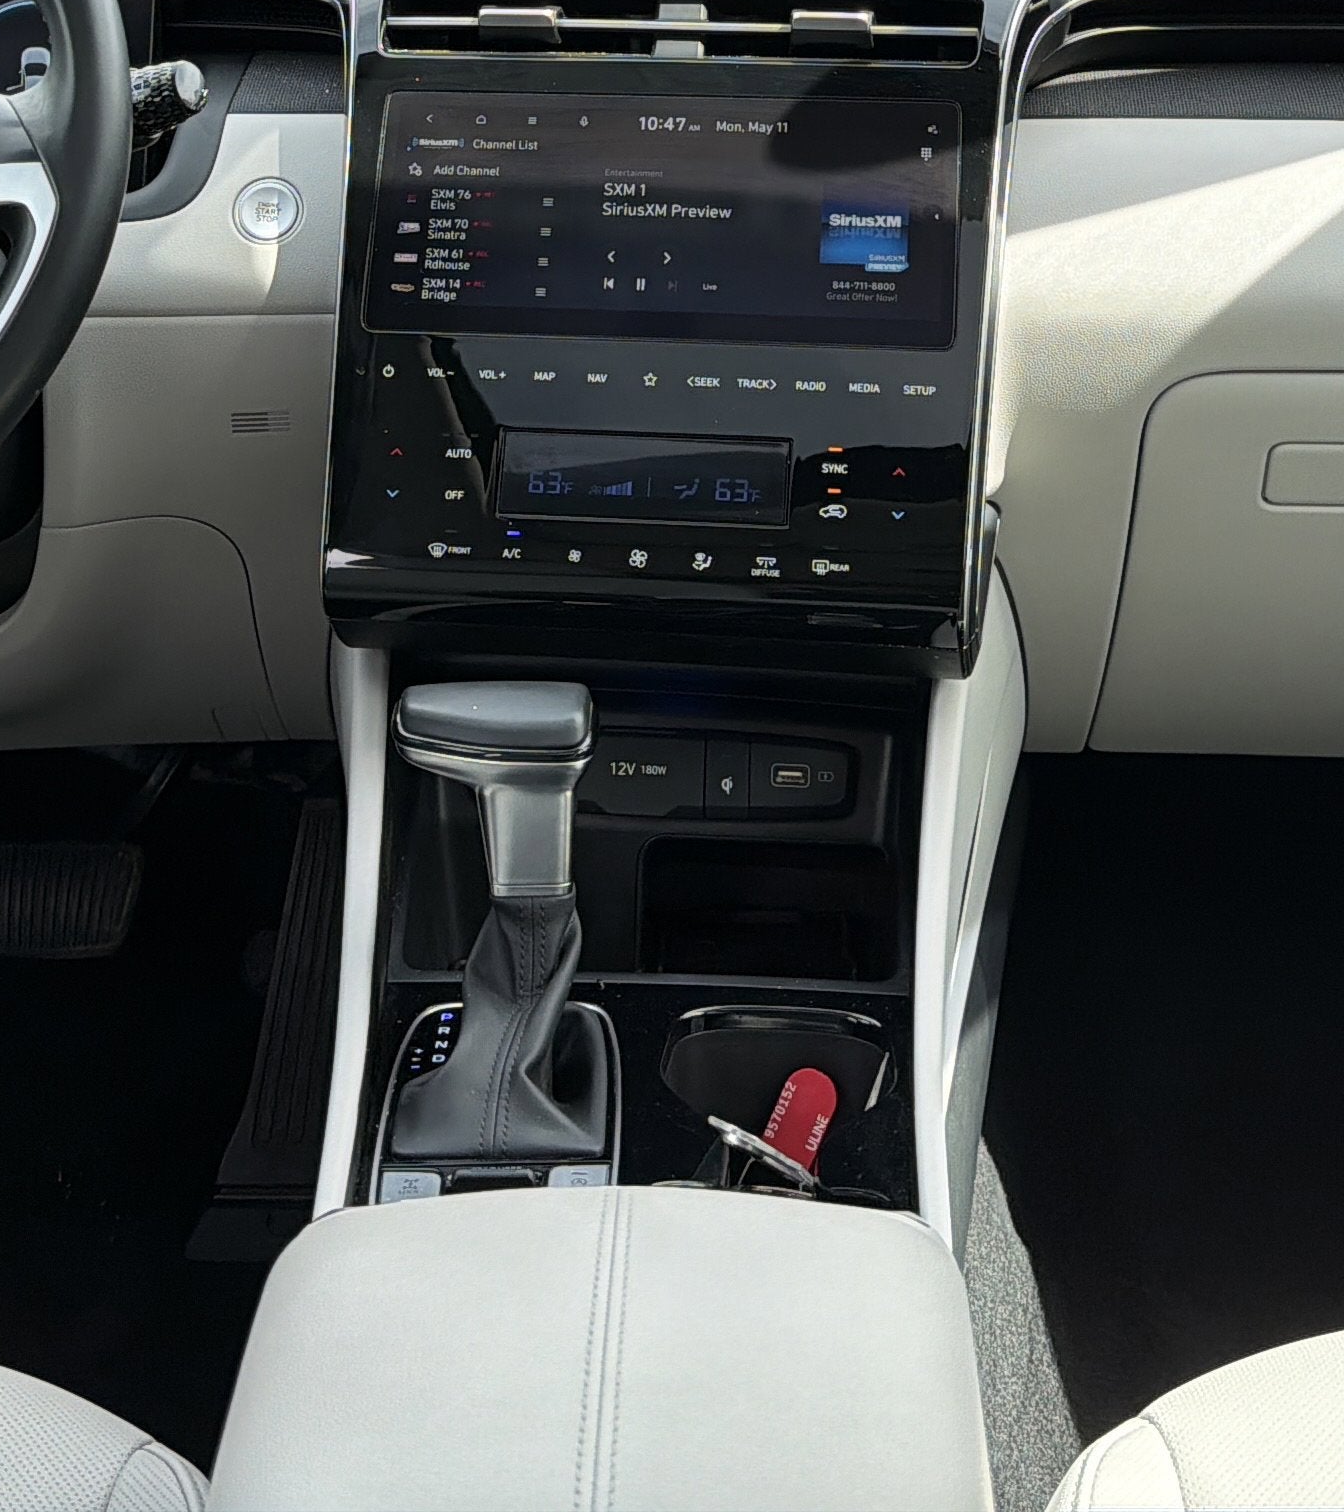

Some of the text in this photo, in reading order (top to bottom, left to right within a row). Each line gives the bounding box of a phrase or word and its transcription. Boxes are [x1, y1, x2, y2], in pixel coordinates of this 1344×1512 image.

[639, 116, 686, 131] 10:47
[716, 121, 745, 133] Mon,
[748, 122, 774, 135] May
[777, 122, 788, 133] 11
[472, 139, 516, 150] Channel
[519, 140, 538, 151] List
[433, 165, 500, 176] Add Channel
[604, 169, 663, 178] Entertainment
[431, 189, 471, 199] SXM 76
[604, 183, 646, 197] SXM 1
[430, 200, 456, 210] Elvis
[255, 208, 282, 216] START
[602, 202, 732, 219] SiriusXM Preview
[428, 218, 452, 229] SXM
[454, 219, 469, 229] 70
[829, 213, 902, 228] SiriusXM
[427, 230, 466, 240] Sinatra
[425, 248, 449, 259] SXM
[451, 249, 463, 259] 61
[424, 260, 471, 270] Rdhouse
[422, 278, 446, 289] SXM
[448, 279, 461, 289] 14
[703, 283, 717, 291] Live
[421, 289, 457, 302] Bridge
[826, 292, 850, 301] Great
[851, 293, 874, 301] Offer
[534, 371, 556, 381] MAP
[587, 373, 608, 383] NAV
[795, 381, 826, 392] RADIO
[849, 382, 880, 393] MEDIA
[903, 384, 936, 396] SETUP
[445, 449, 472, 459] AUTO
[822, 463, 848, 474] SYNC
[445, 490, 465, 500] OFF
[448, 546, 471, 555] FRONT
[502, 548, 522, 559] A/C
[830, 563, 850, 573] REAR
[751, 569, 780, 578] DIFFUSE
[610, 762, 667, 776] 12V 180W
[441, 1012, 454, 1022] P
[437, 1026, 451, 1035] R
[435, 1040, 449, 1049] N
[431, 1054, 446, 1063] D
[764, 1081, 797, 1139] 9570152
[805, 1113, 829, 1151] ULINE
